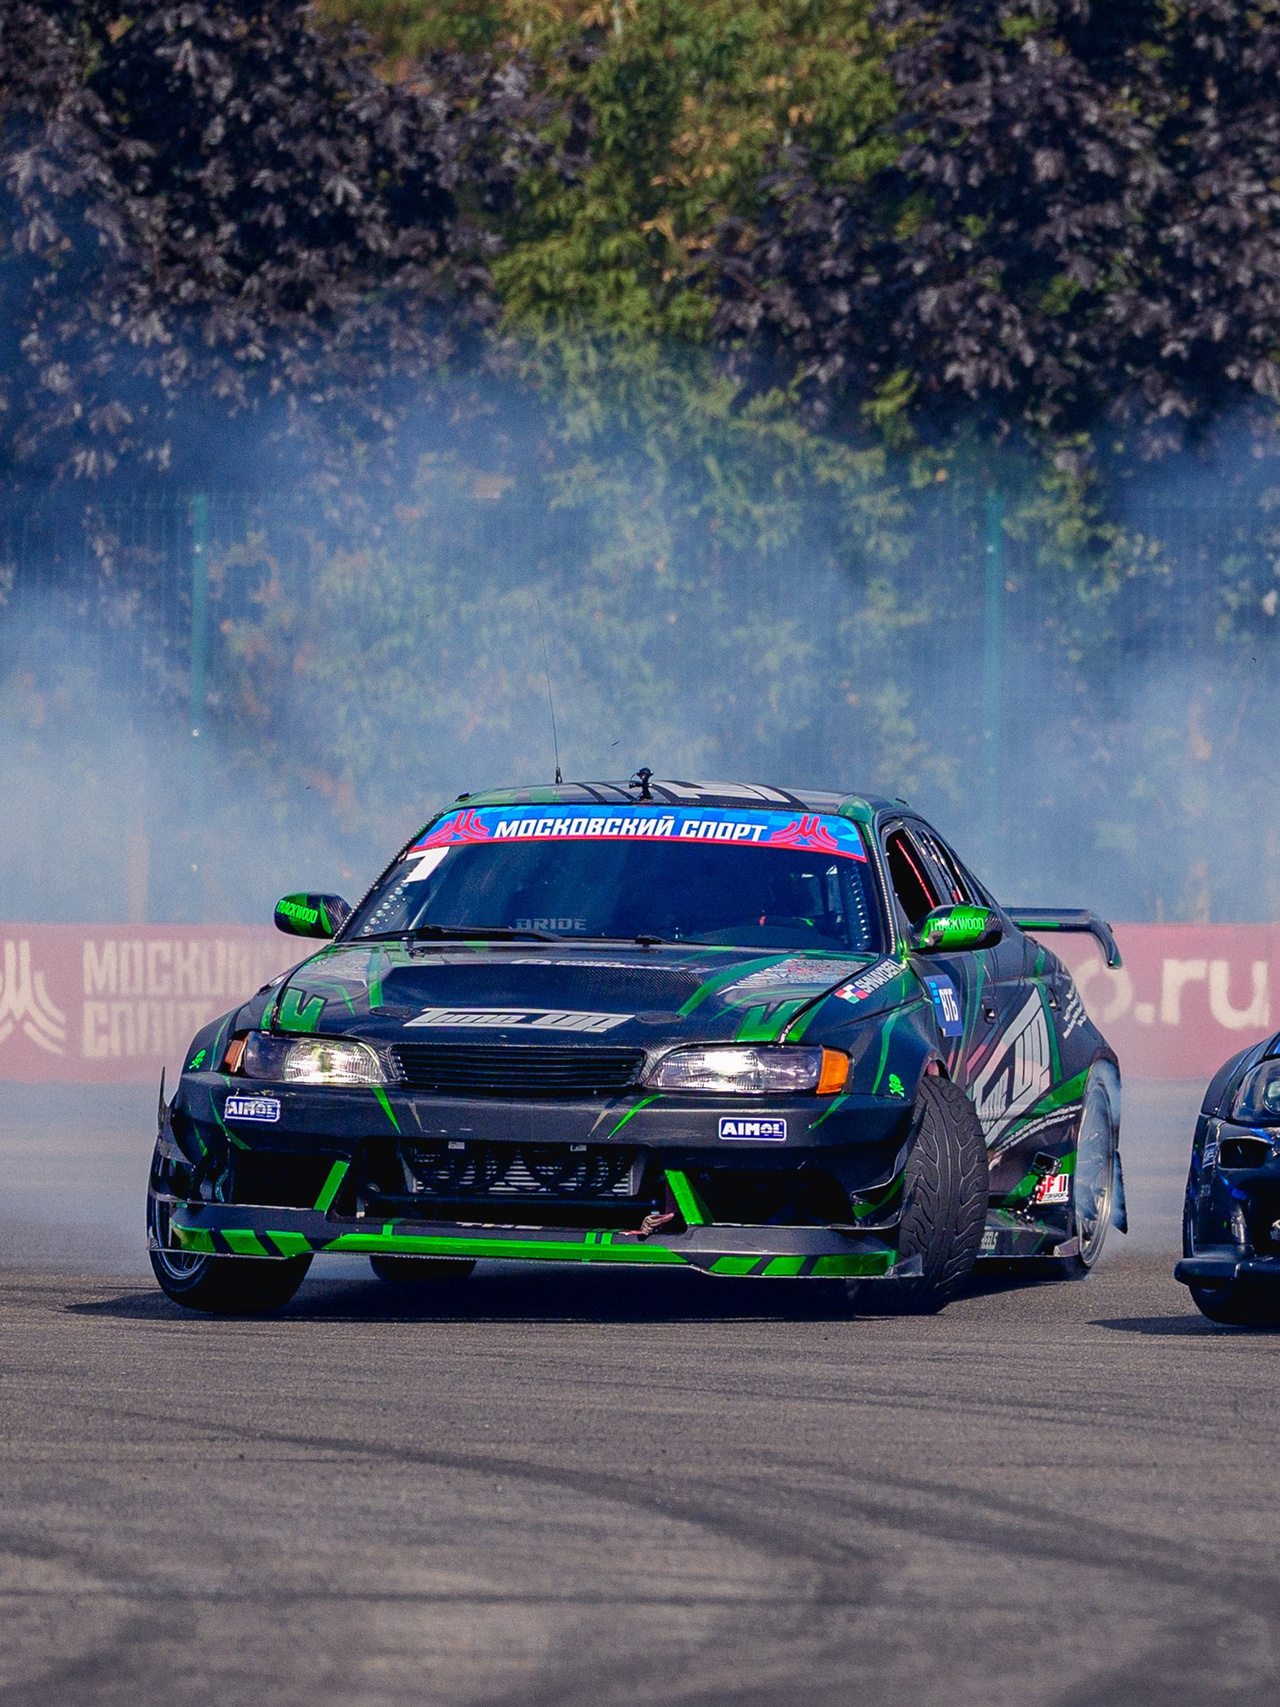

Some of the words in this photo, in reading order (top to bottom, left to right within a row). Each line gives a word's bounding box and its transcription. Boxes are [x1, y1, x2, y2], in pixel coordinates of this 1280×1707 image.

[493, 815, 675, 838] МОСКОВСКИЙ
[679, 819, 768, 842] СПОРТ
[515, 917, 588, 931] BRIDE
[938, 988, 959, 1022] ВТБ
[721, 1121, 783, 1137] AIMOL
